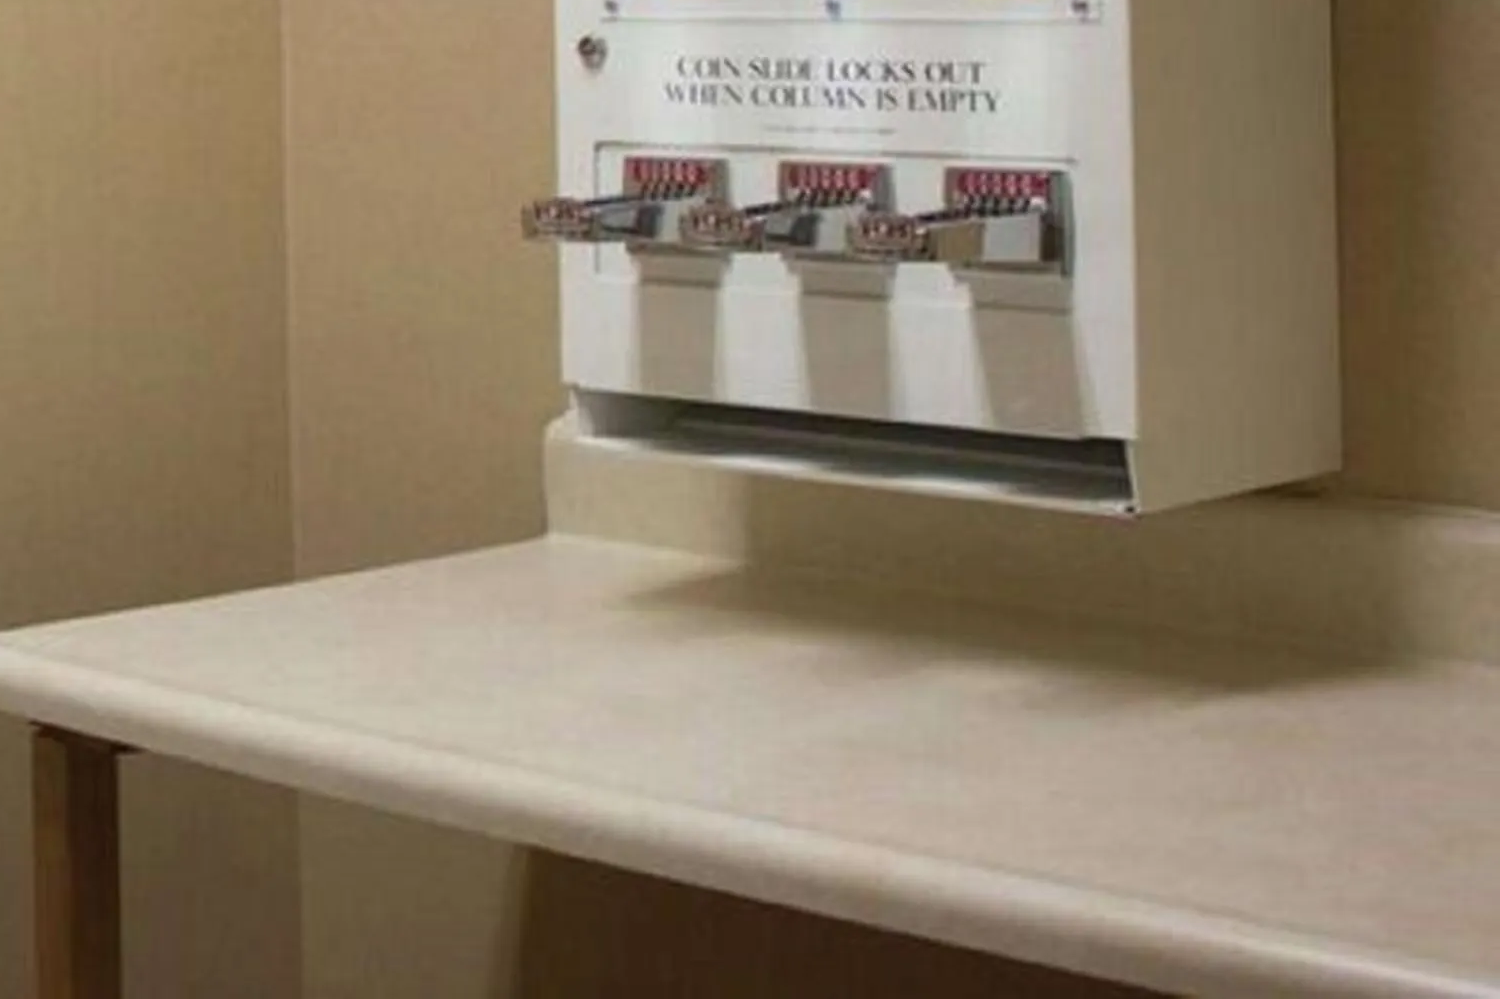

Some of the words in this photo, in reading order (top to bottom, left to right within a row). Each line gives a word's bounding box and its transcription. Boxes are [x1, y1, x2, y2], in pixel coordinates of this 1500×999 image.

[677, 57, 741, 78] COIN
[826, 58, 916, 83] LOCKS
[925, 62, 986, 84] OUT
[665, 83, 744, 106] WHEN
[750, 86, 867, 110] COLUMN
[876, 88, 899, 112] IS
[907, 89, 1002, 113] EMPTY
